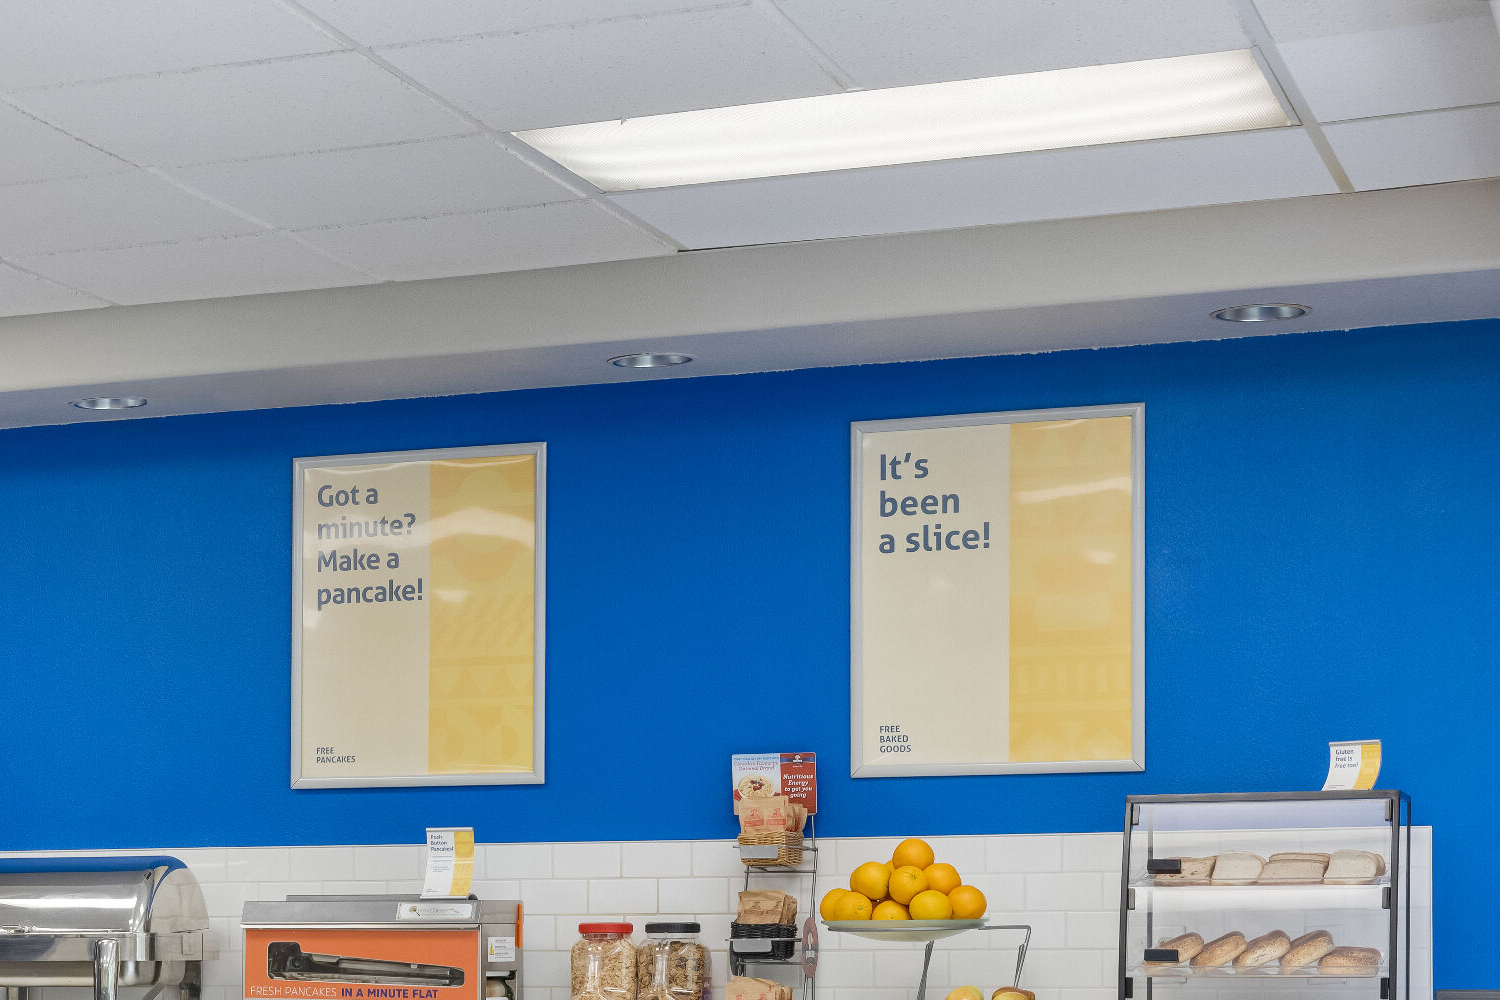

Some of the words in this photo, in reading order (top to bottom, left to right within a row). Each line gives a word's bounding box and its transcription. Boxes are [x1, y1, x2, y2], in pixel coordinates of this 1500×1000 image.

[880, 452, 929, 480] It’s
[317, 484, 360, 507] Got
[365, 488, 379, 505] a
[879, 490, 960, 518] been
[317, 512, 417, 540] minute?
[879, 533, 895, 554] a
[905, 521, 990, 553] slice!
[317, 548, 381, 573] Make
[386, 552, 400, 569] a
[317, 577, 423, 612] pancake!
[879, 725, 901, 733] FREE
[879, 735, 909, 743] BAKED
[316, 746, 335, 755] FREE
[879, 745, 912, 753] GOODS
[316, 755, 356, 763] PANCAKES
[801, 785, 813, 793] you
[250, 986, 282, 997] FRESH
[284, 987, 337, 998] PANCAKES
[341, 988, 353, 998] IN
[355, 988, 364, 998] A
[367, 988, 409, 999] MINUTE
[412, 989, 439, 999] FLAT
